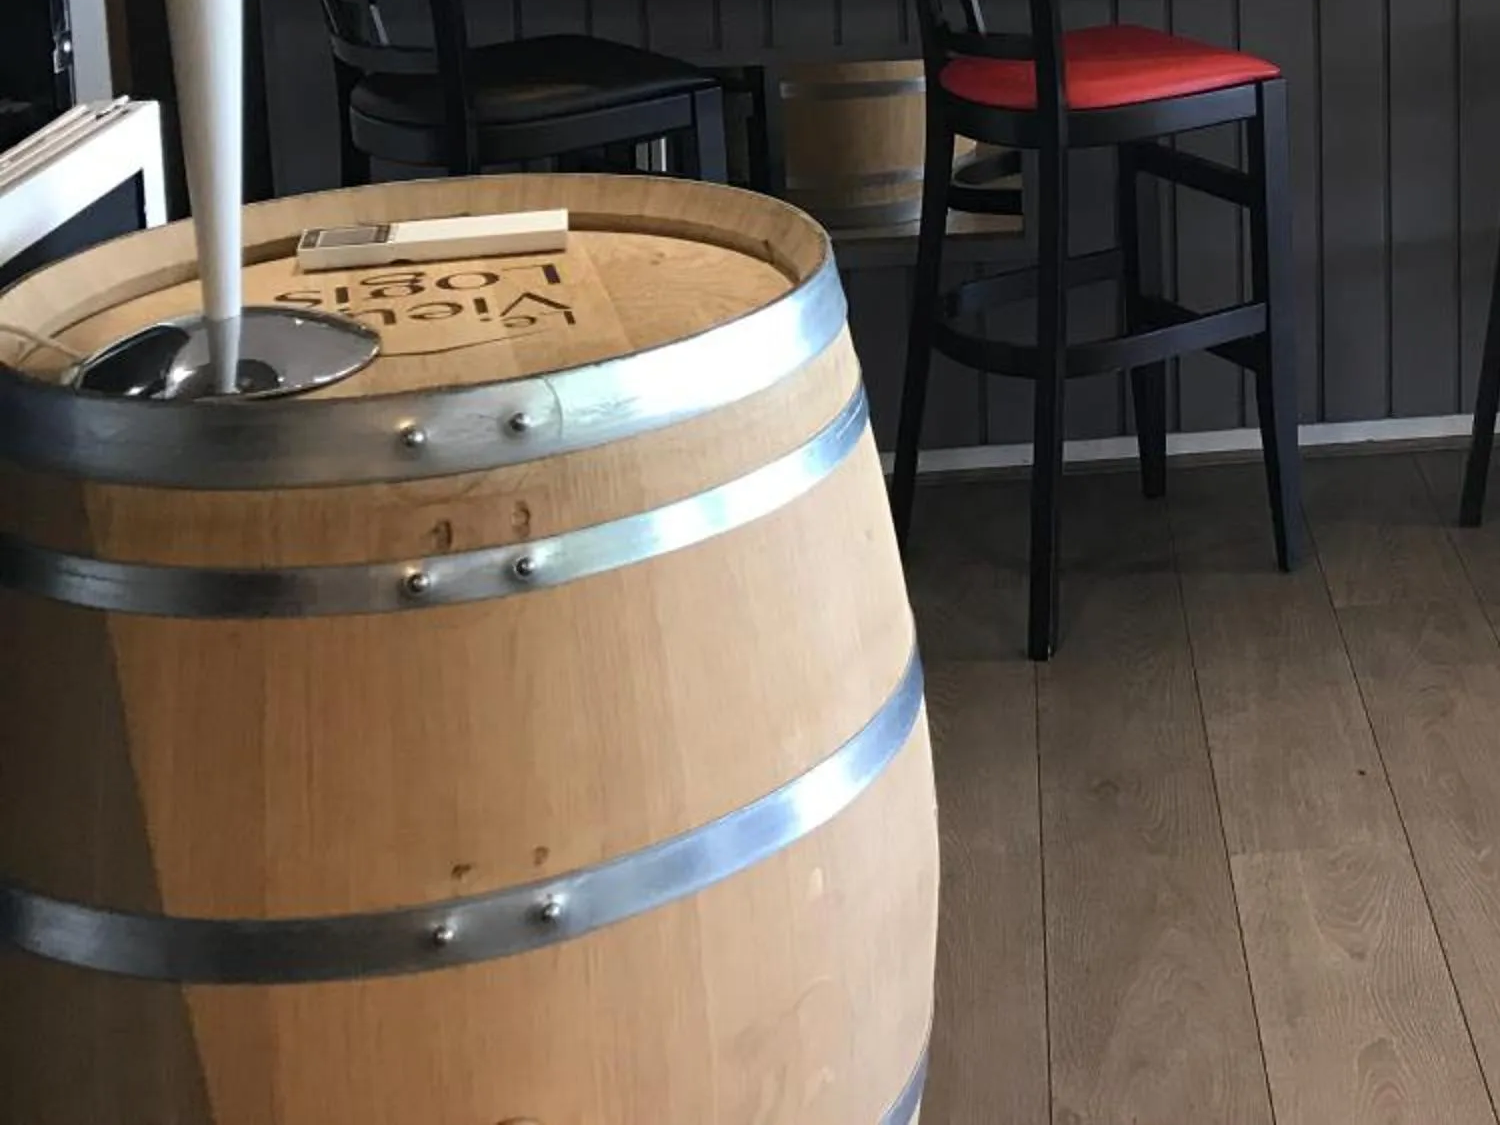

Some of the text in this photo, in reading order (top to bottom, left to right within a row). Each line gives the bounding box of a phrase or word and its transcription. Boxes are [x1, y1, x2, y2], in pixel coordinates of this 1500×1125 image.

[273, 263, 561, 309] Logis
[346, 291, 574, 326] Vieu
[502, 308, 577, 328] Le
